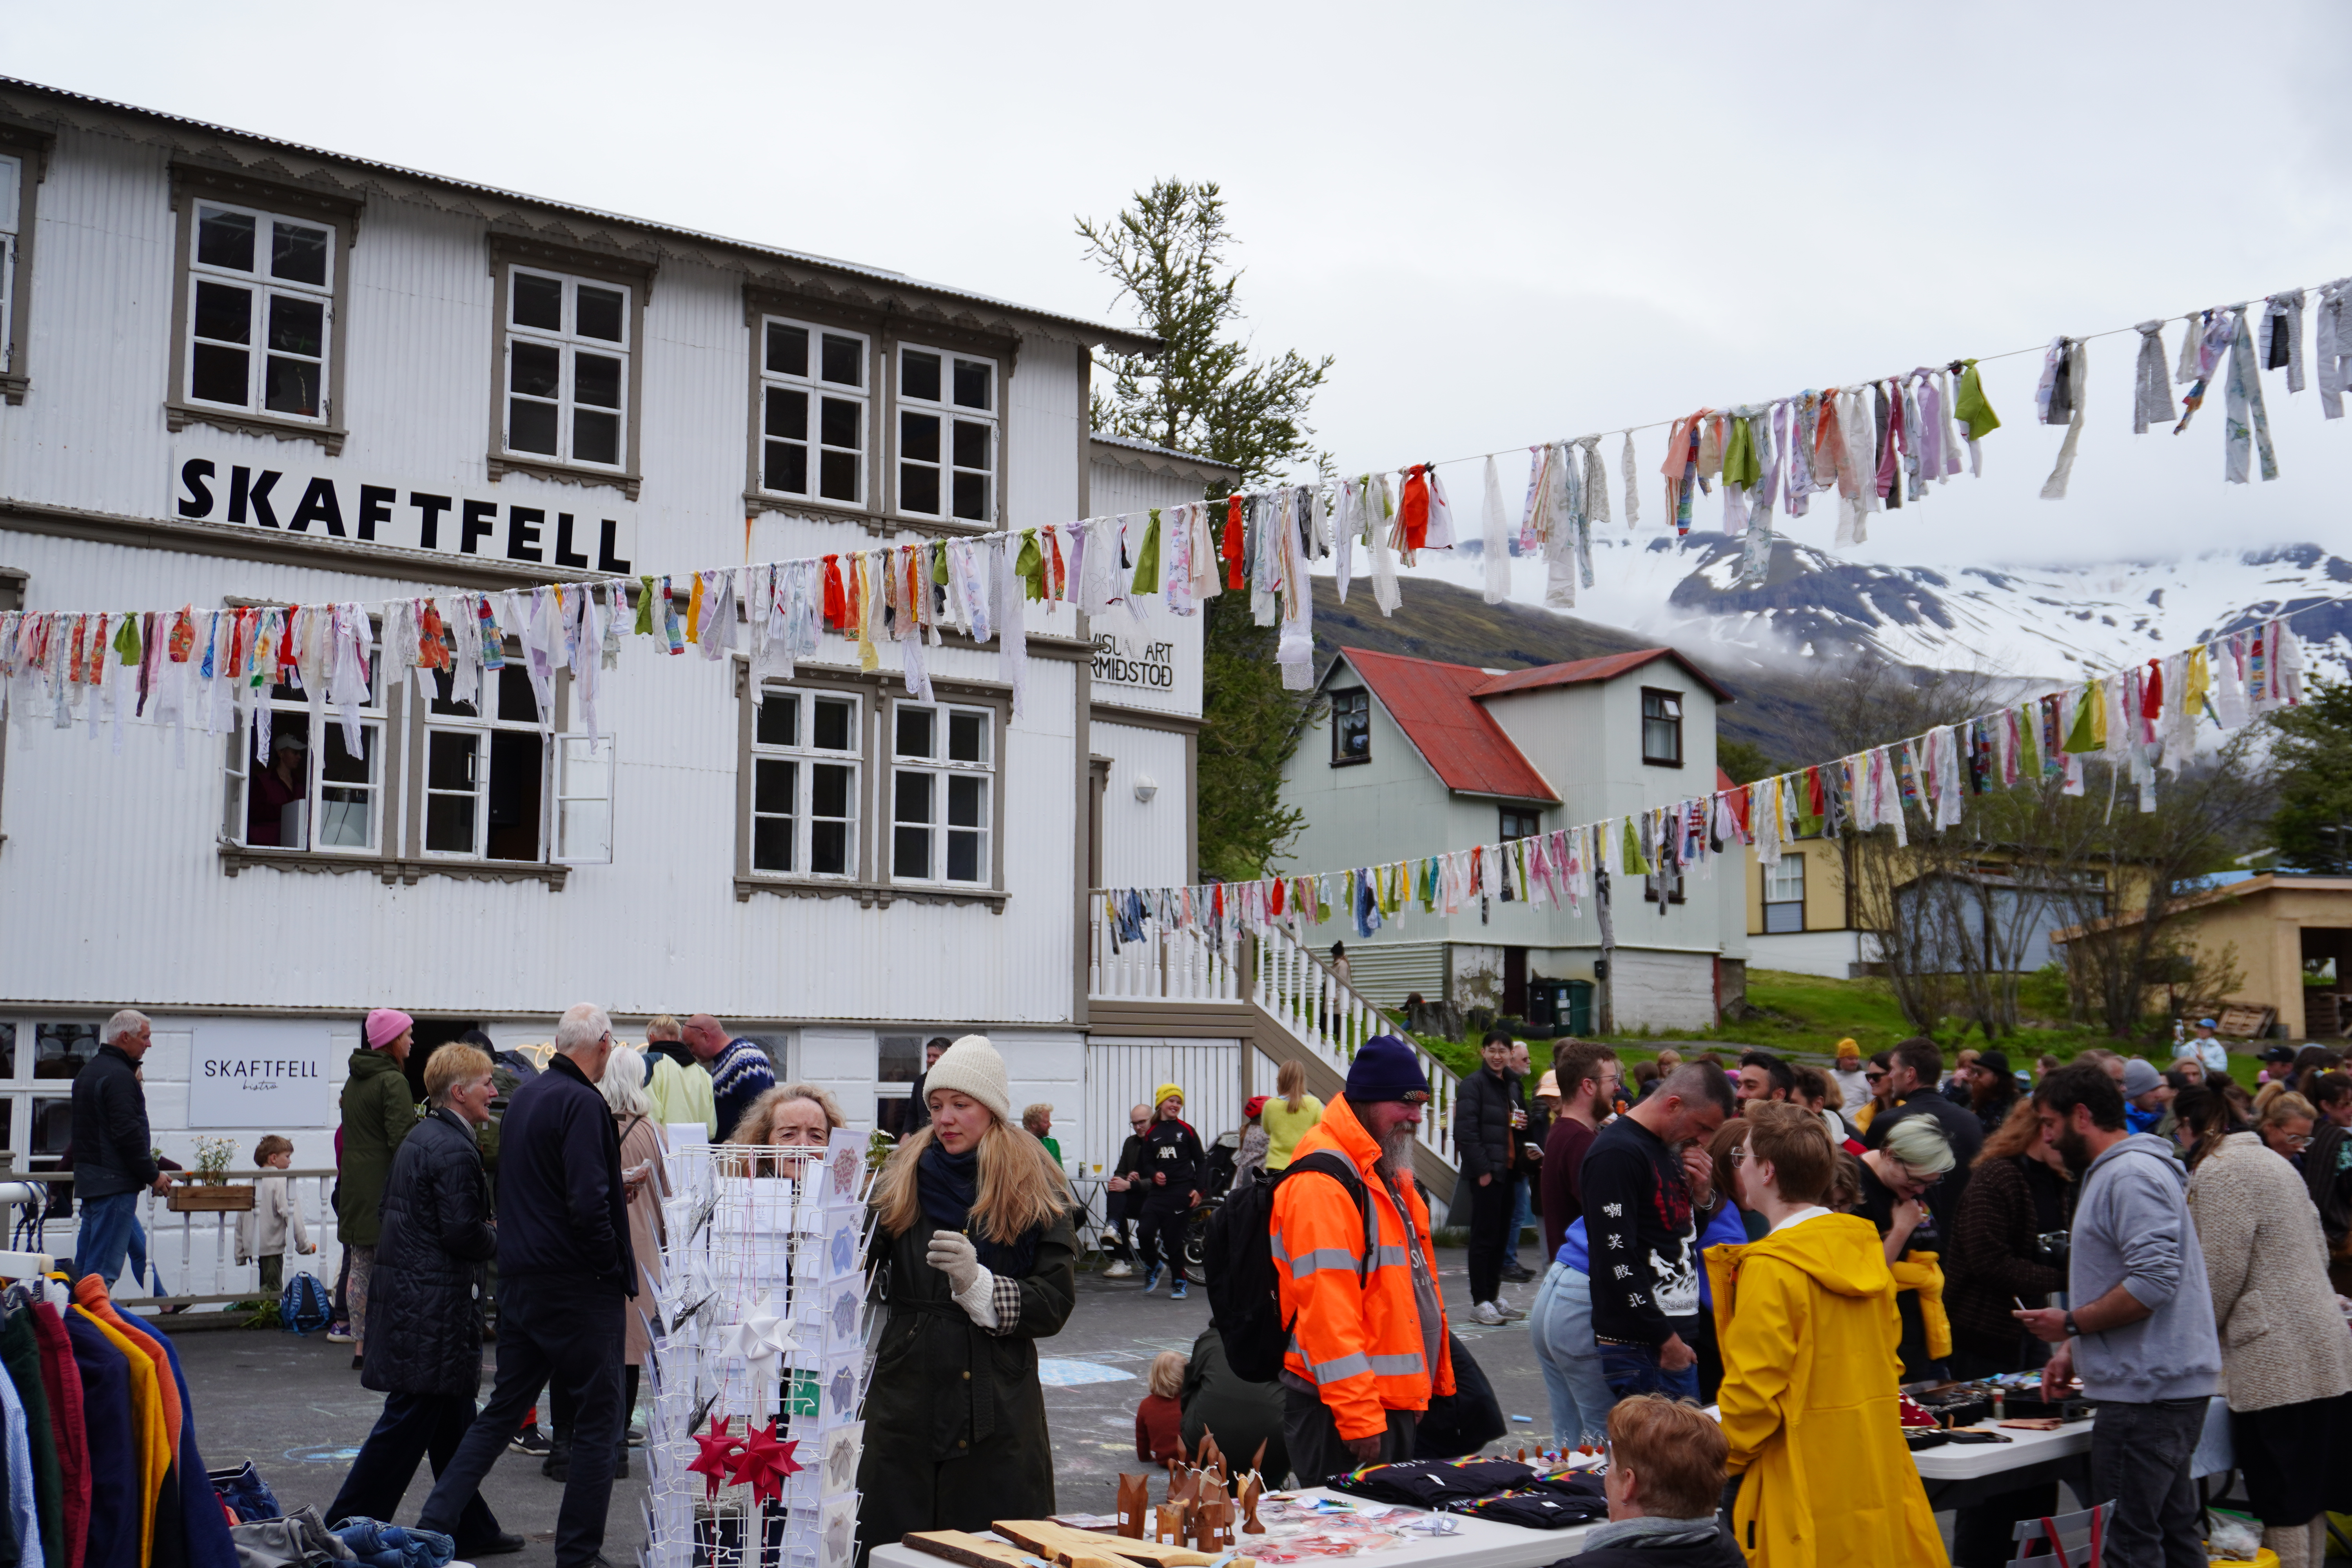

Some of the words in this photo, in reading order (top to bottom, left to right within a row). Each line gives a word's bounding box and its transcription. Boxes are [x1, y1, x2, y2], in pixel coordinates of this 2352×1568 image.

[178, 458, 631, 574] SKAFTFELL
[1145, 642, 1173, 663] ART
[205, 1060, 318, 1077] SKAFTFELL
[243, 1079, 279, 1091] bistro
[1156, 1147, 1177, 1159] AXA
[1603, 1203, 1646, 1307] 嘲笑敗北
